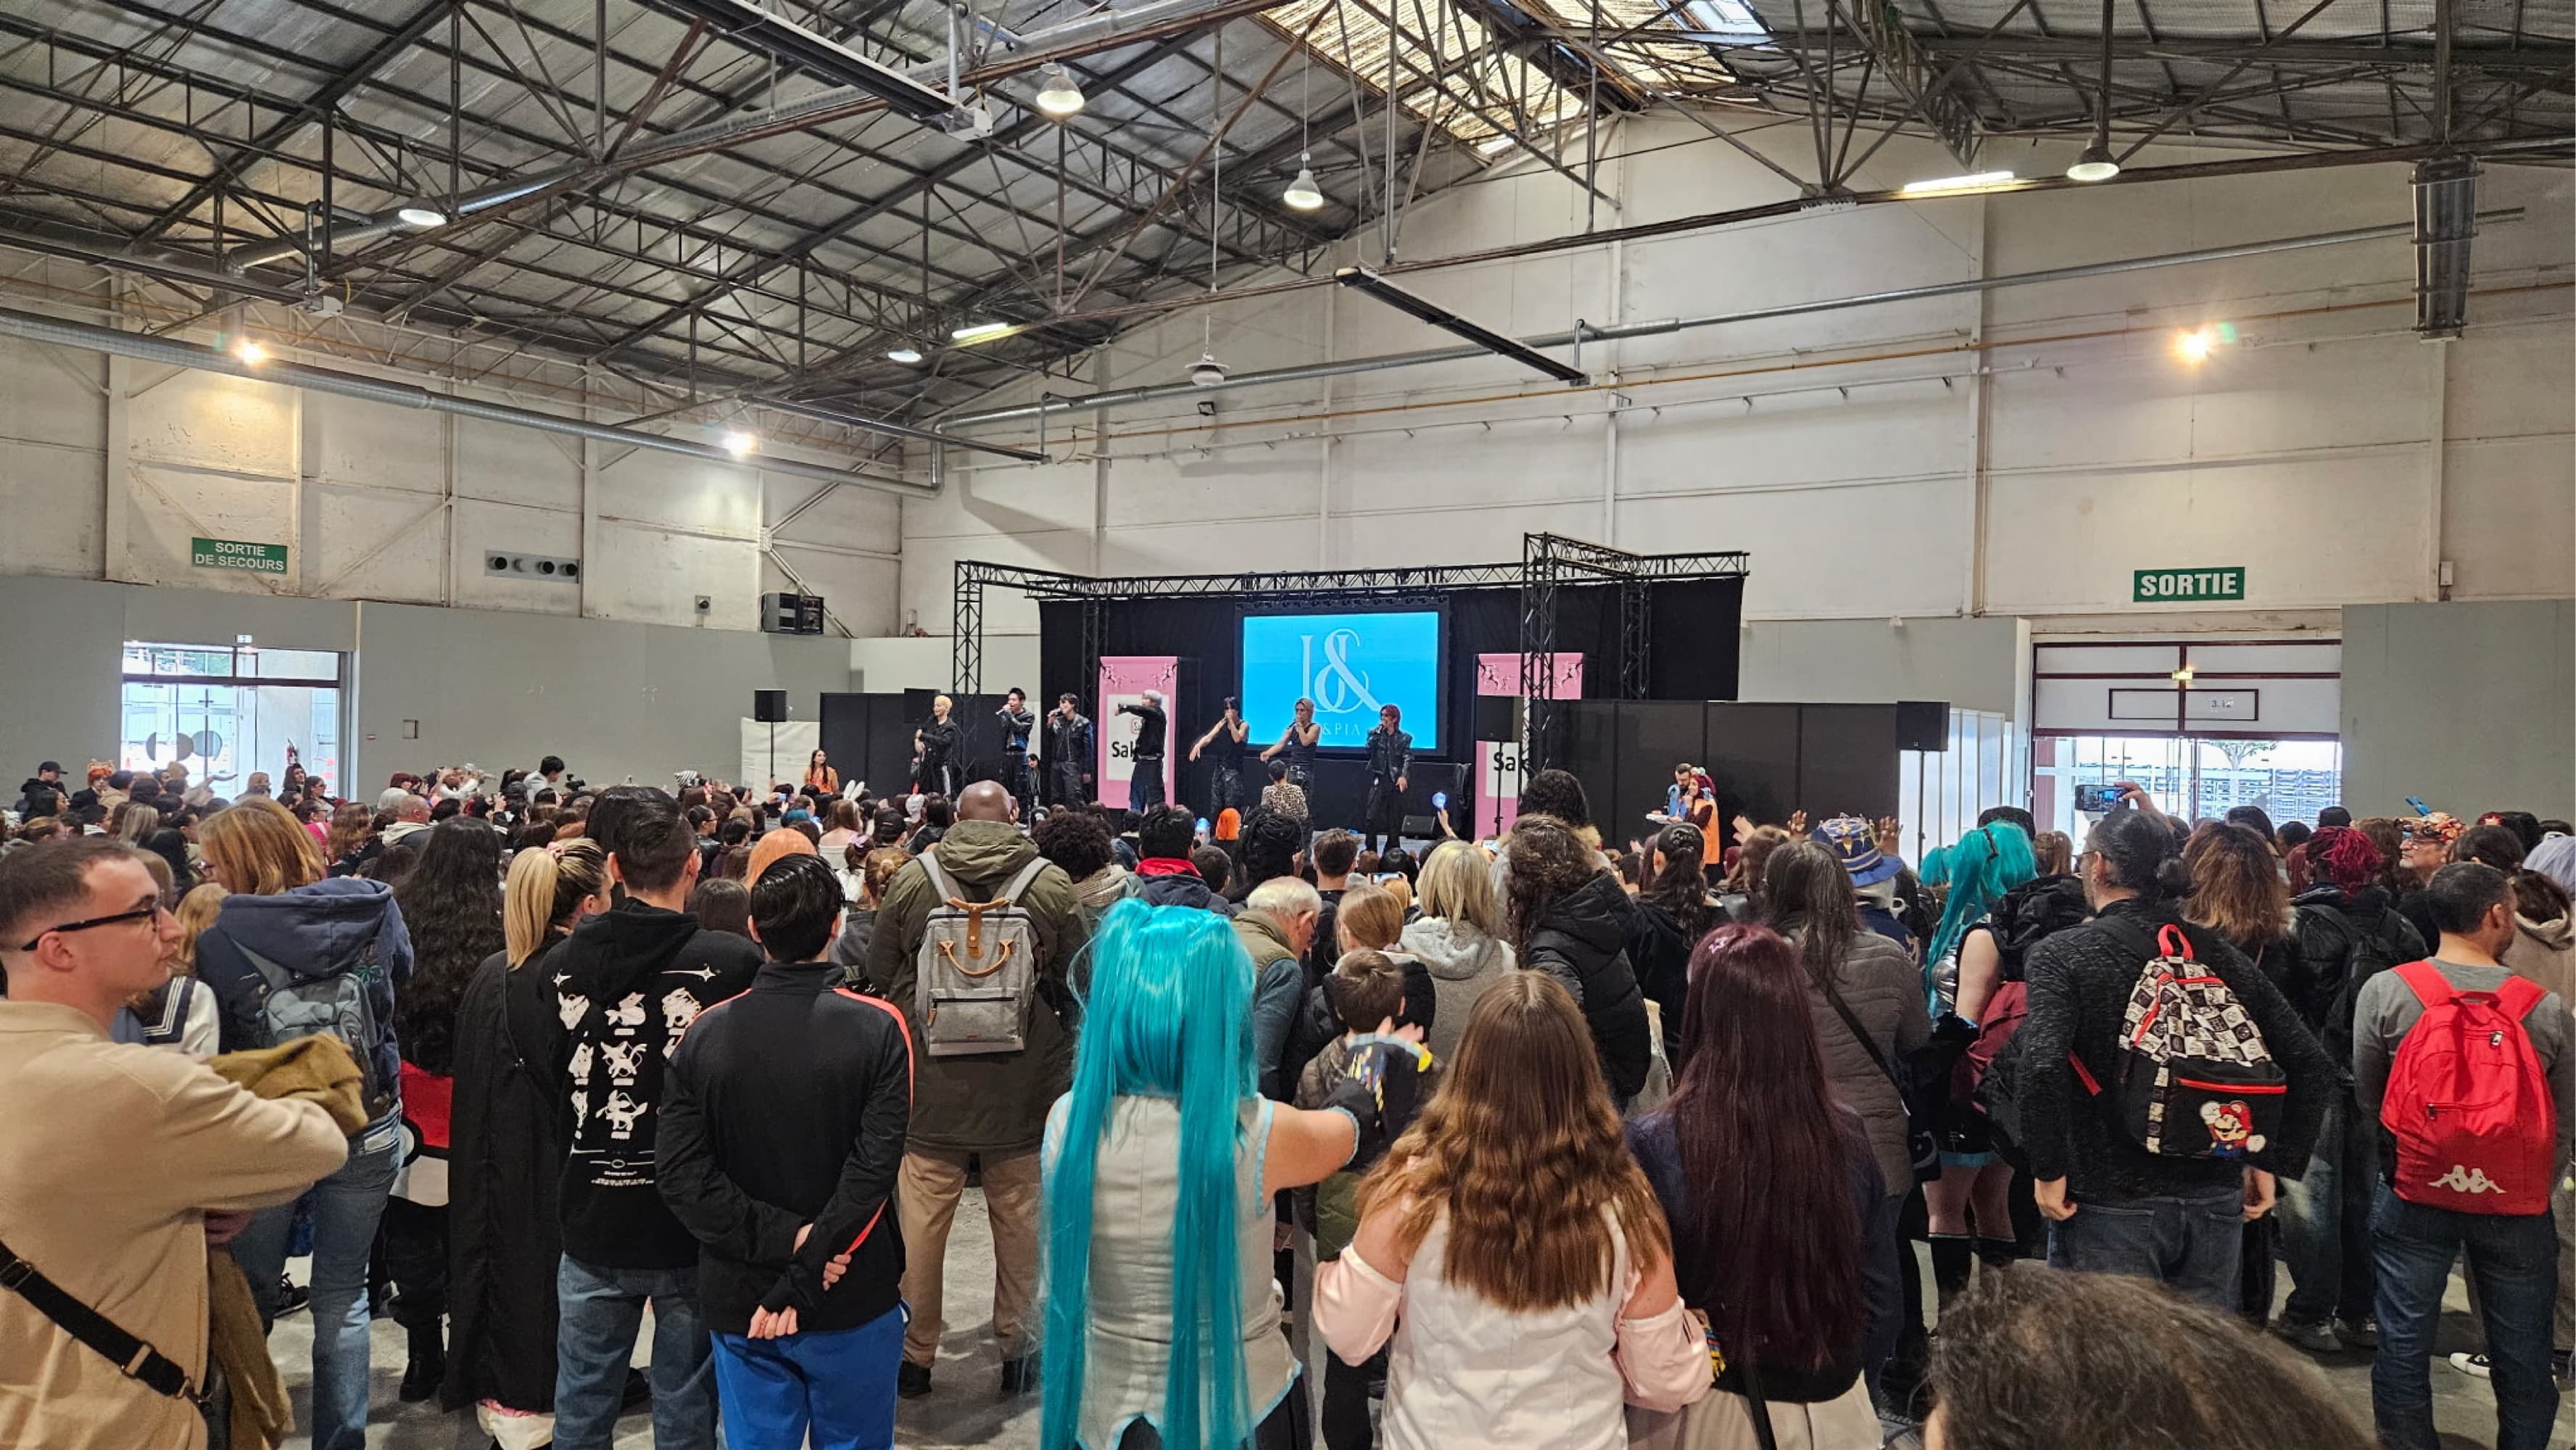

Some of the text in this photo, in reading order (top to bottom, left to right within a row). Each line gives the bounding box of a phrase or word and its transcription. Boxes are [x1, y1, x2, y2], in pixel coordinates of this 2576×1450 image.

[215, 542, 266, 557] SORTIE
[195, 554, 284, 571] DE SECOURS
[2140, 573, 2238, 596] SORTIE
